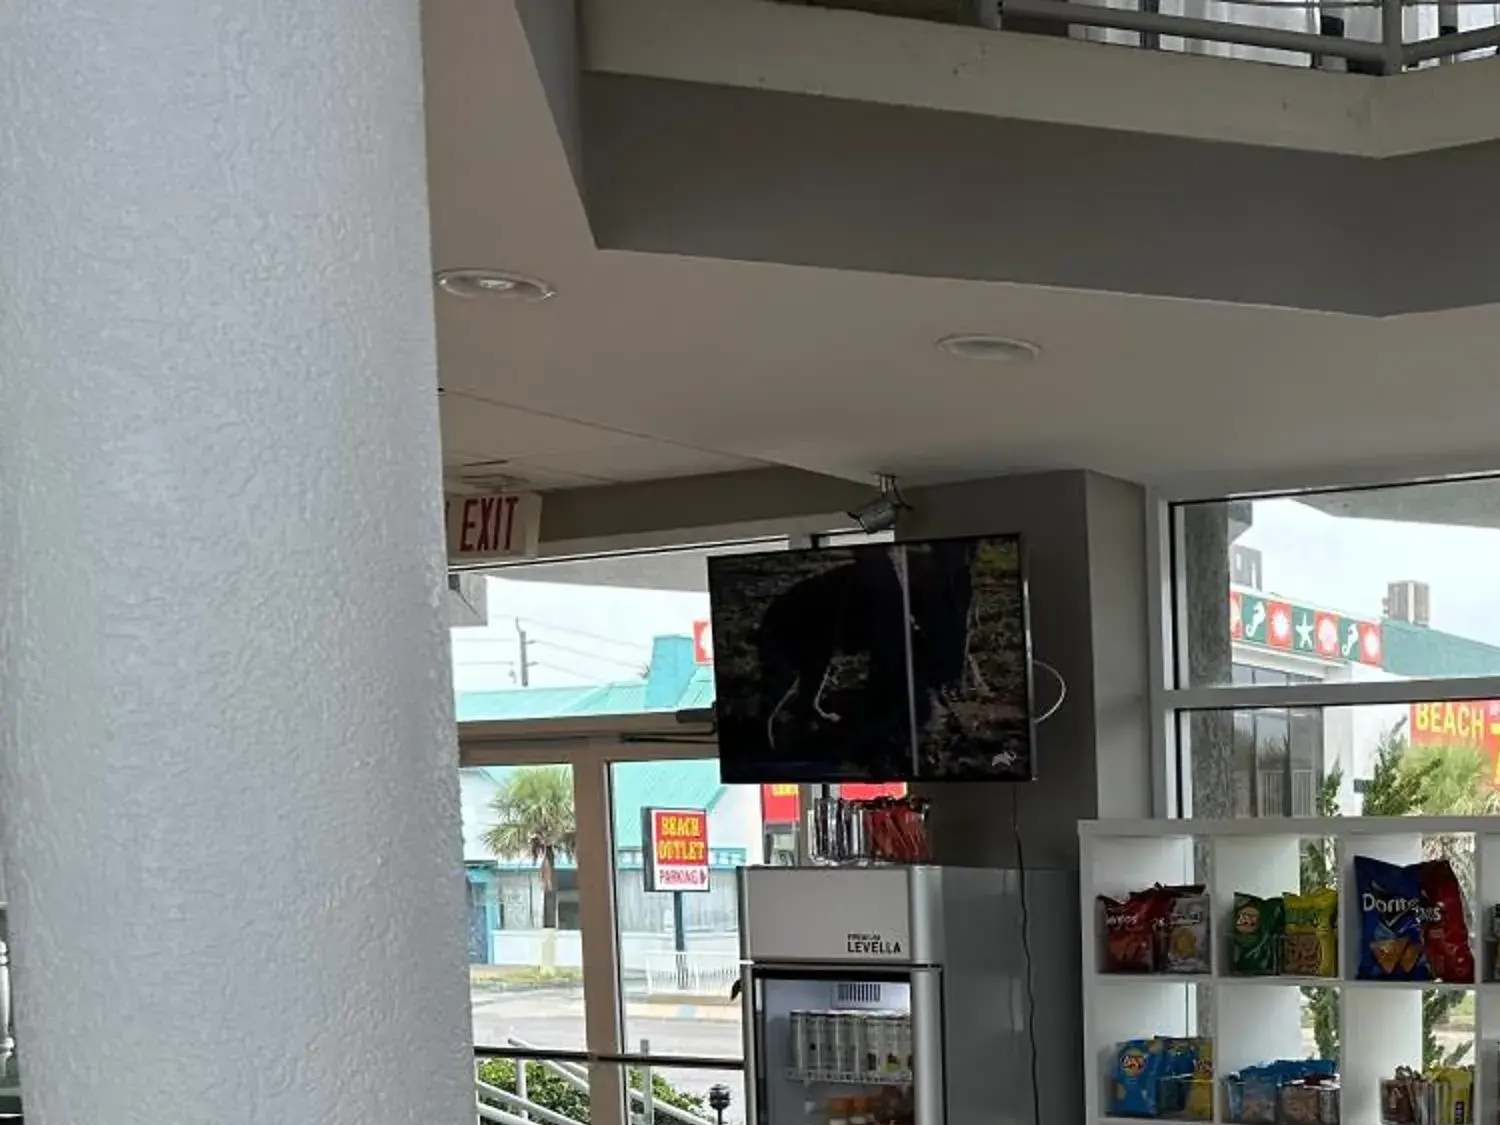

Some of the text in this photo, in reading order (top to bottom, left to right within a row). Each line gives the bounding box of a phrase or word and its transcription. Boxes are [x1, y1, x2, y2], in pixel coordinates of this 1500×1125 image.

[459, 496, 519, 552] EXIT
[1415, 702, 1485, 741] BEACH
[661, 816, 700, 838] BEACH
[659, 840, 704, 861] OUTLET
[1363, 893, 1420, 913] Dorito
[847, 942, 902, 955] LEVELLA
